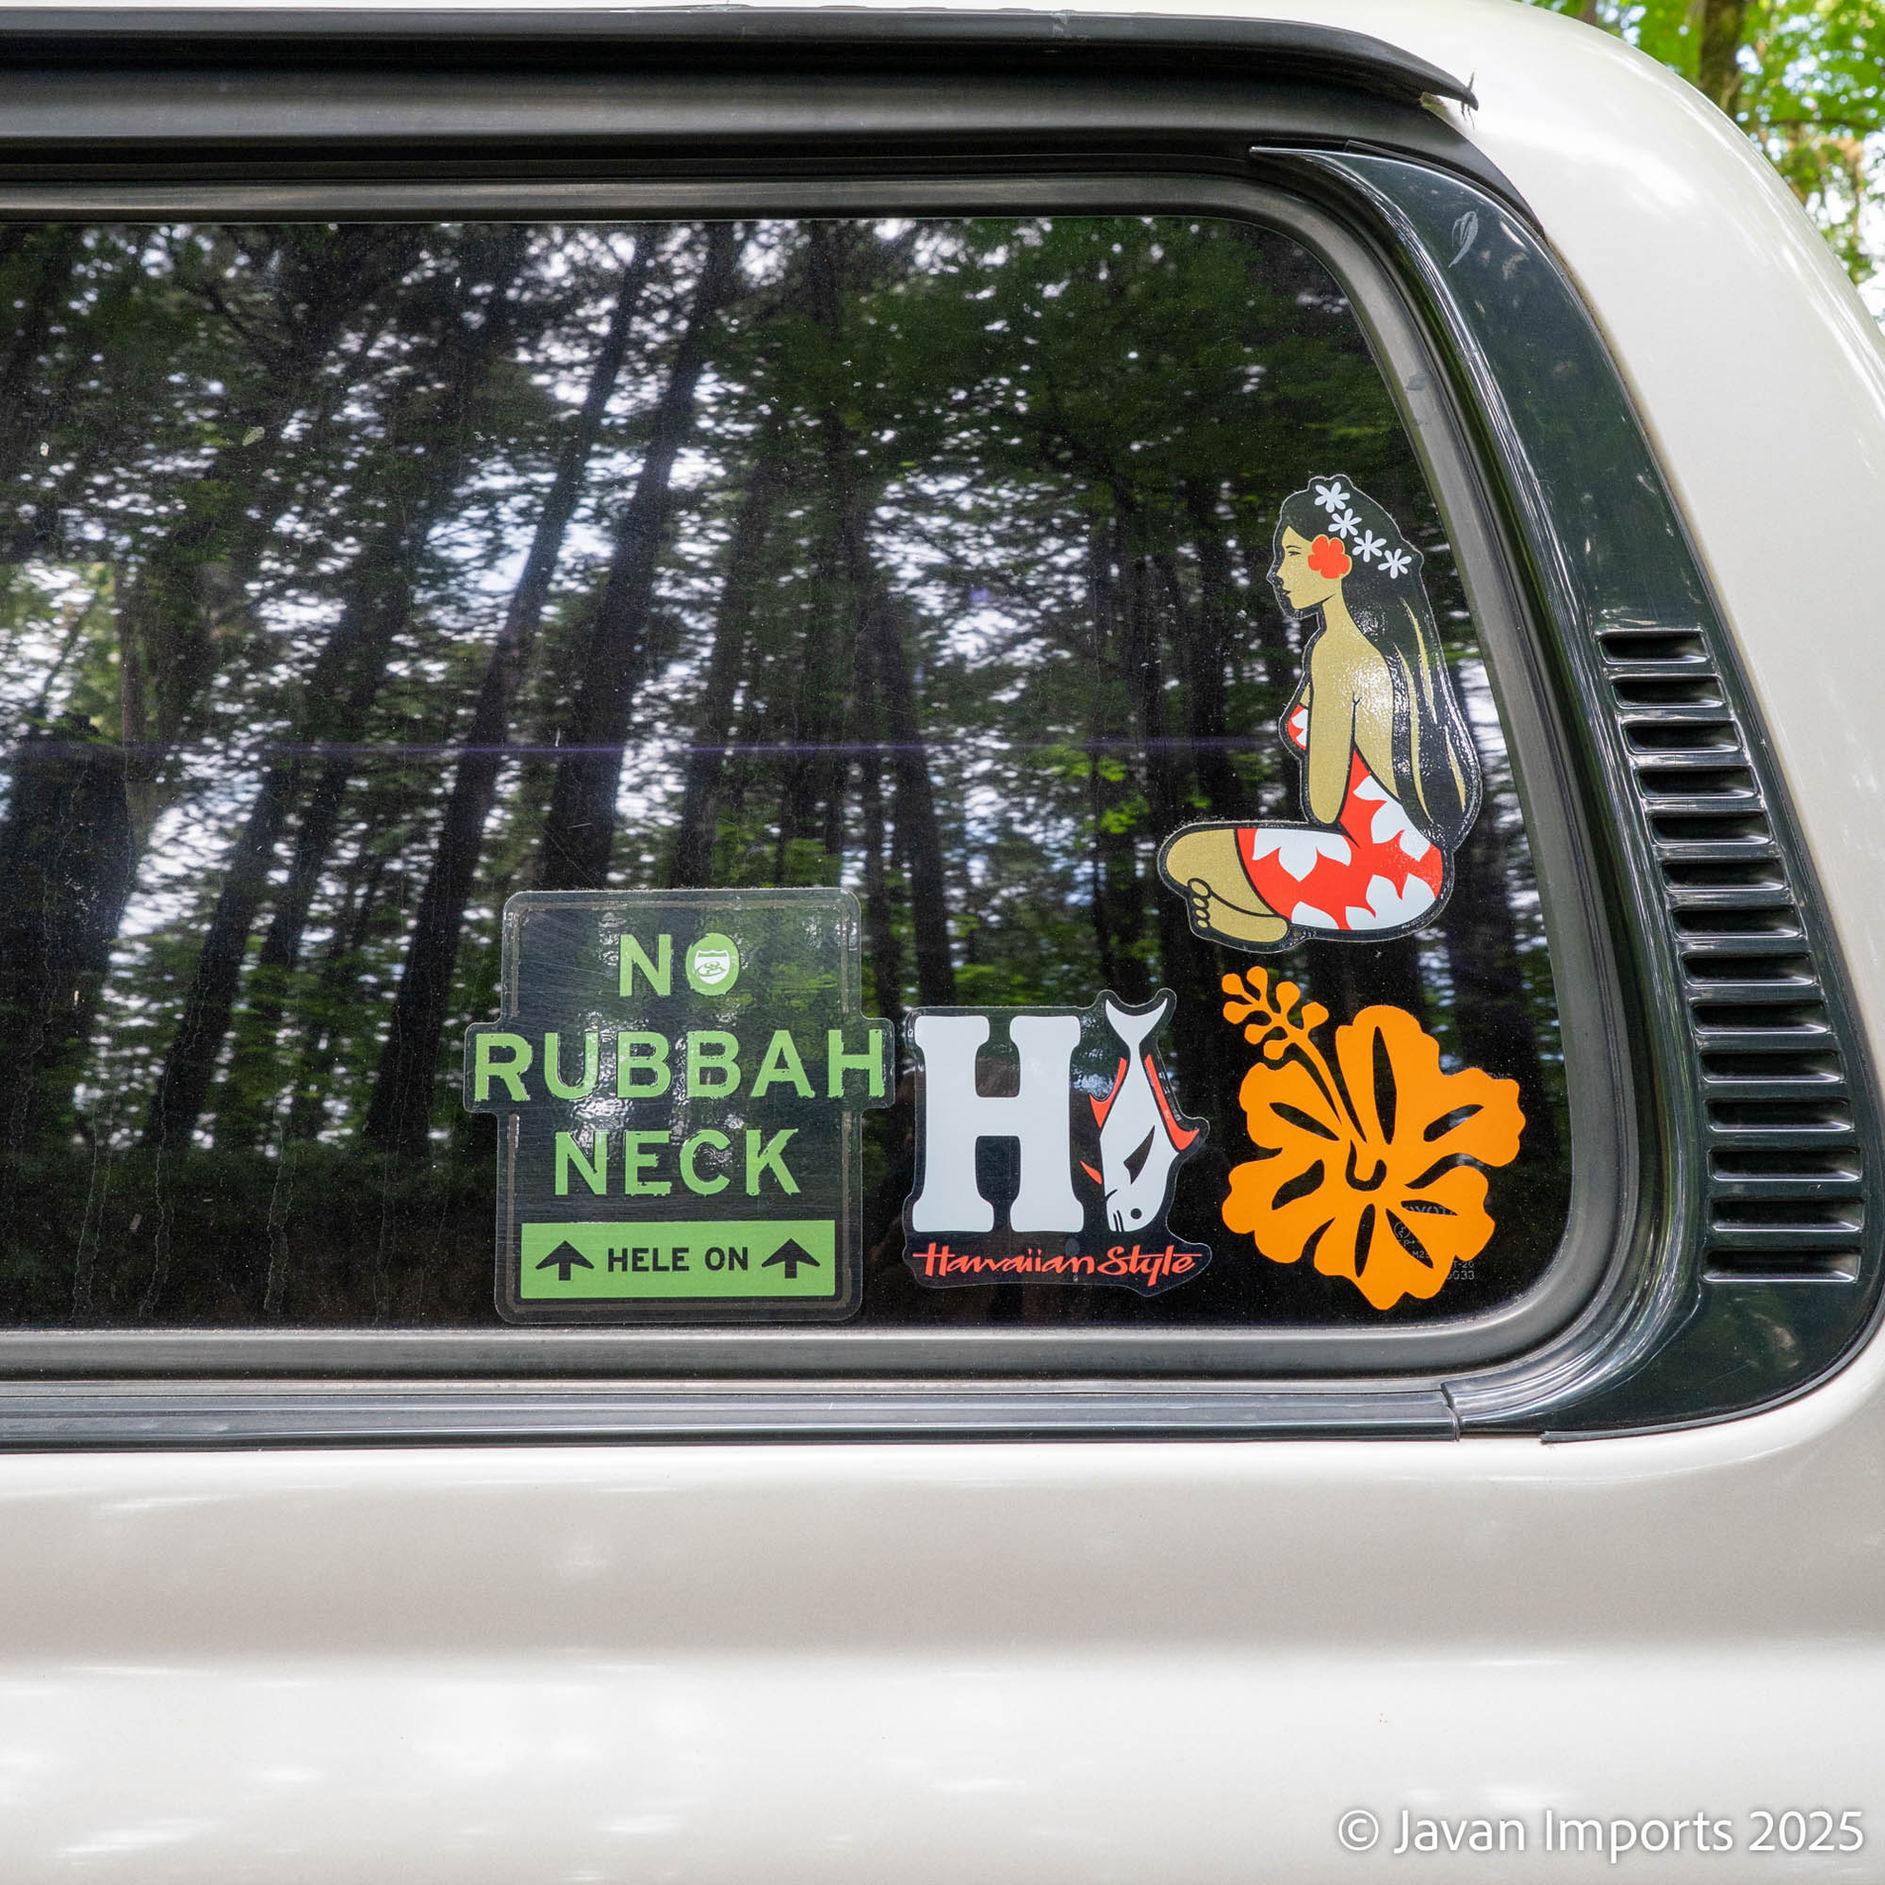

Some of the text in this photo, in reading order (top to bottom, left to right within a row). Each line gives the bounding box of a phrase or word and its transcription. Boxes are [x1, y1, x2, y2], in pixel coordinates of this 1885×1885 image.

[619, 933, 740, 997] NO
[474, 1029, 886, 1101] RUBBAH
[554, 1129, 800, 1196] NECK
[607, 1246, 749, 1273] HELE ON
[912, 1242, 1203, 1287] Hawaiian Style
